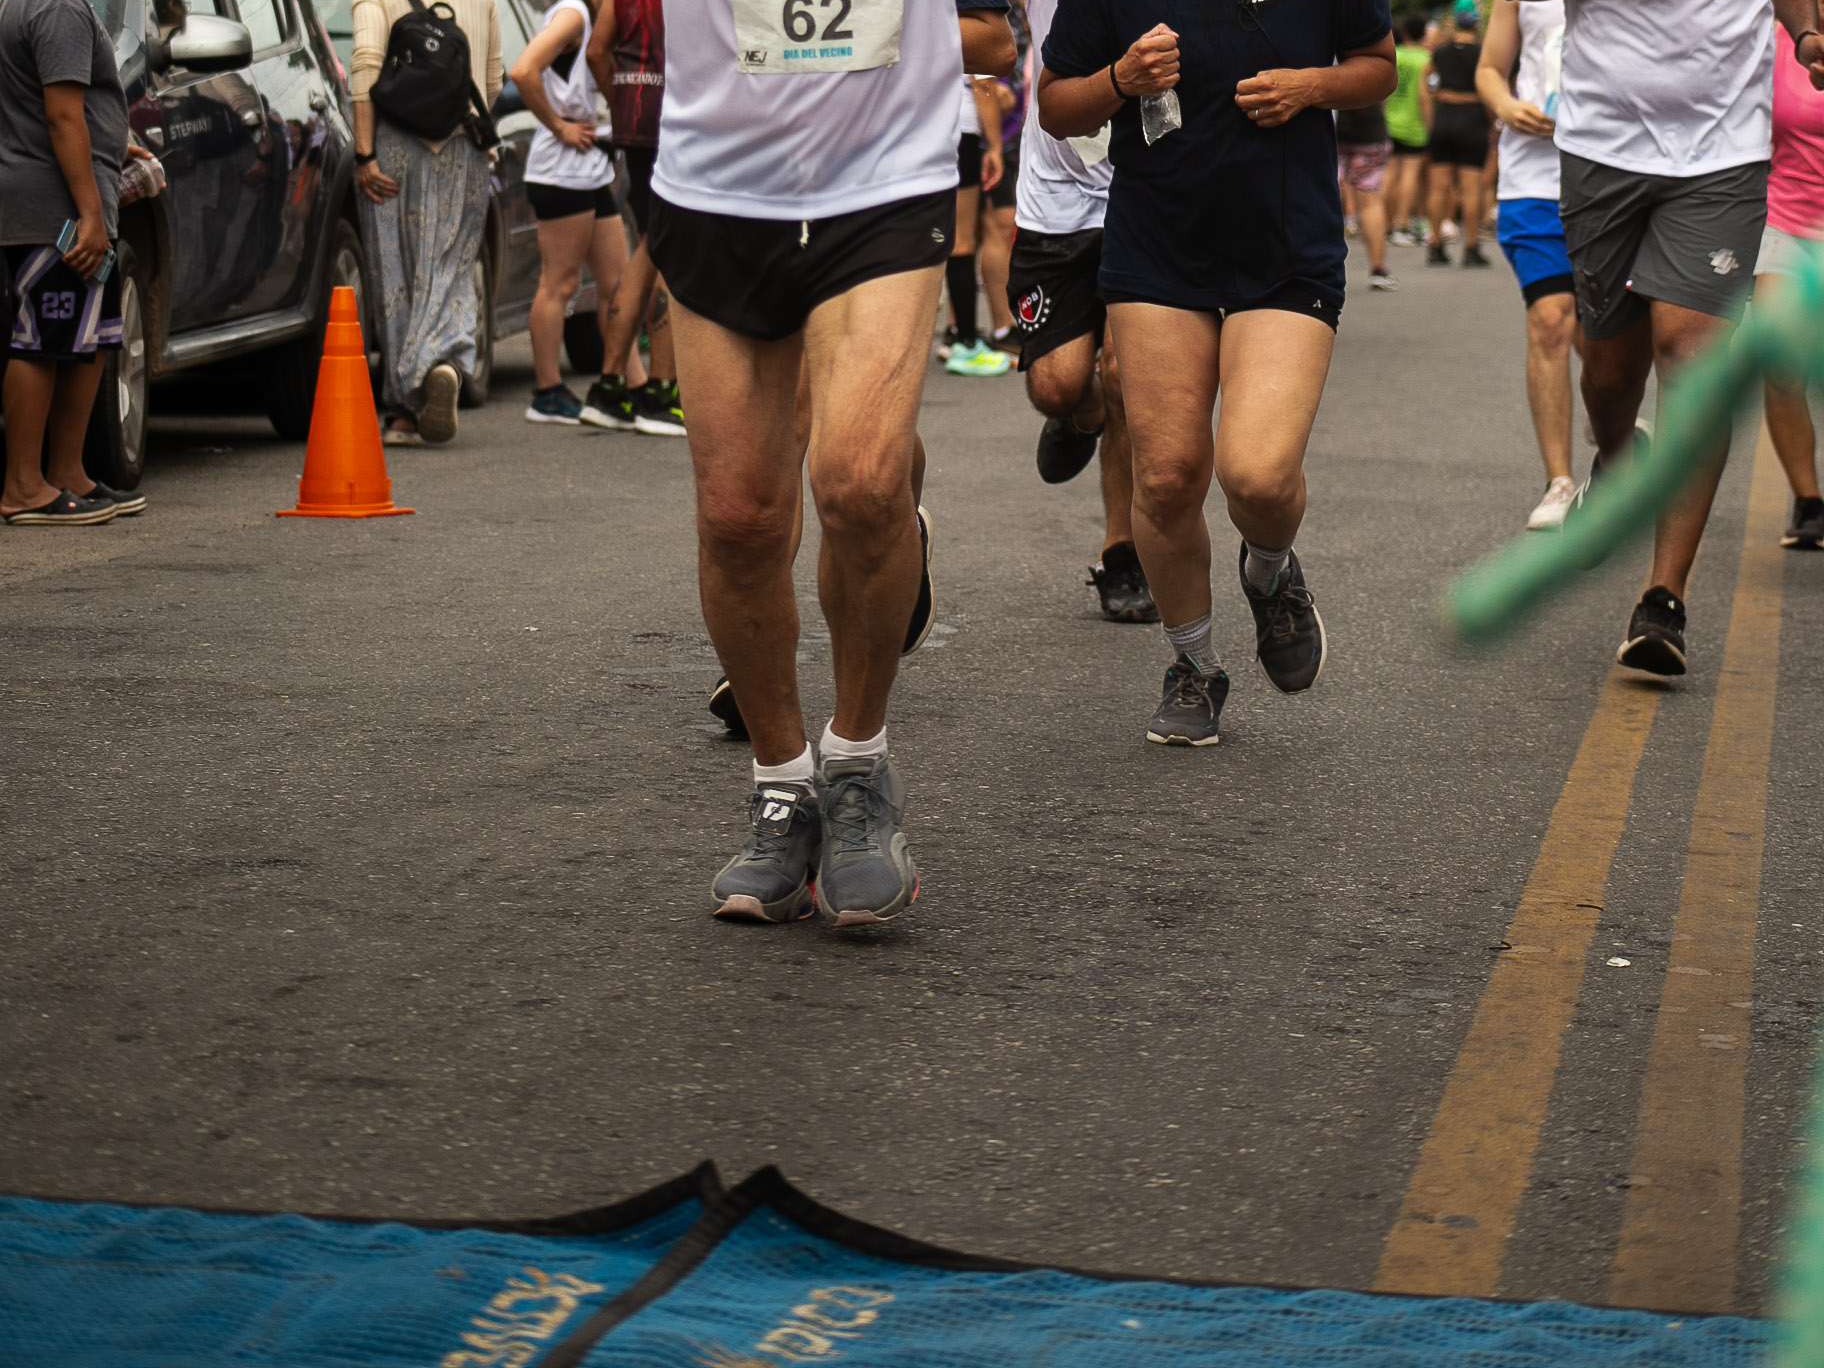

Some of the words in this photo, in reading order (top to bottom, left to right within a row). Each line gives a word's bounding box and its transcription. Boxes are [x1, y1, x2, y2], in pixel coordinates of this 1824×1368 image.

[784, 49, 800, 60] DIA
[802, 48, 817, 59] DEL
[819, 46, 853, 58] VECINO
[169, 115, 209, 140] STEPWAY
[42, 291, 76, 319] 23
